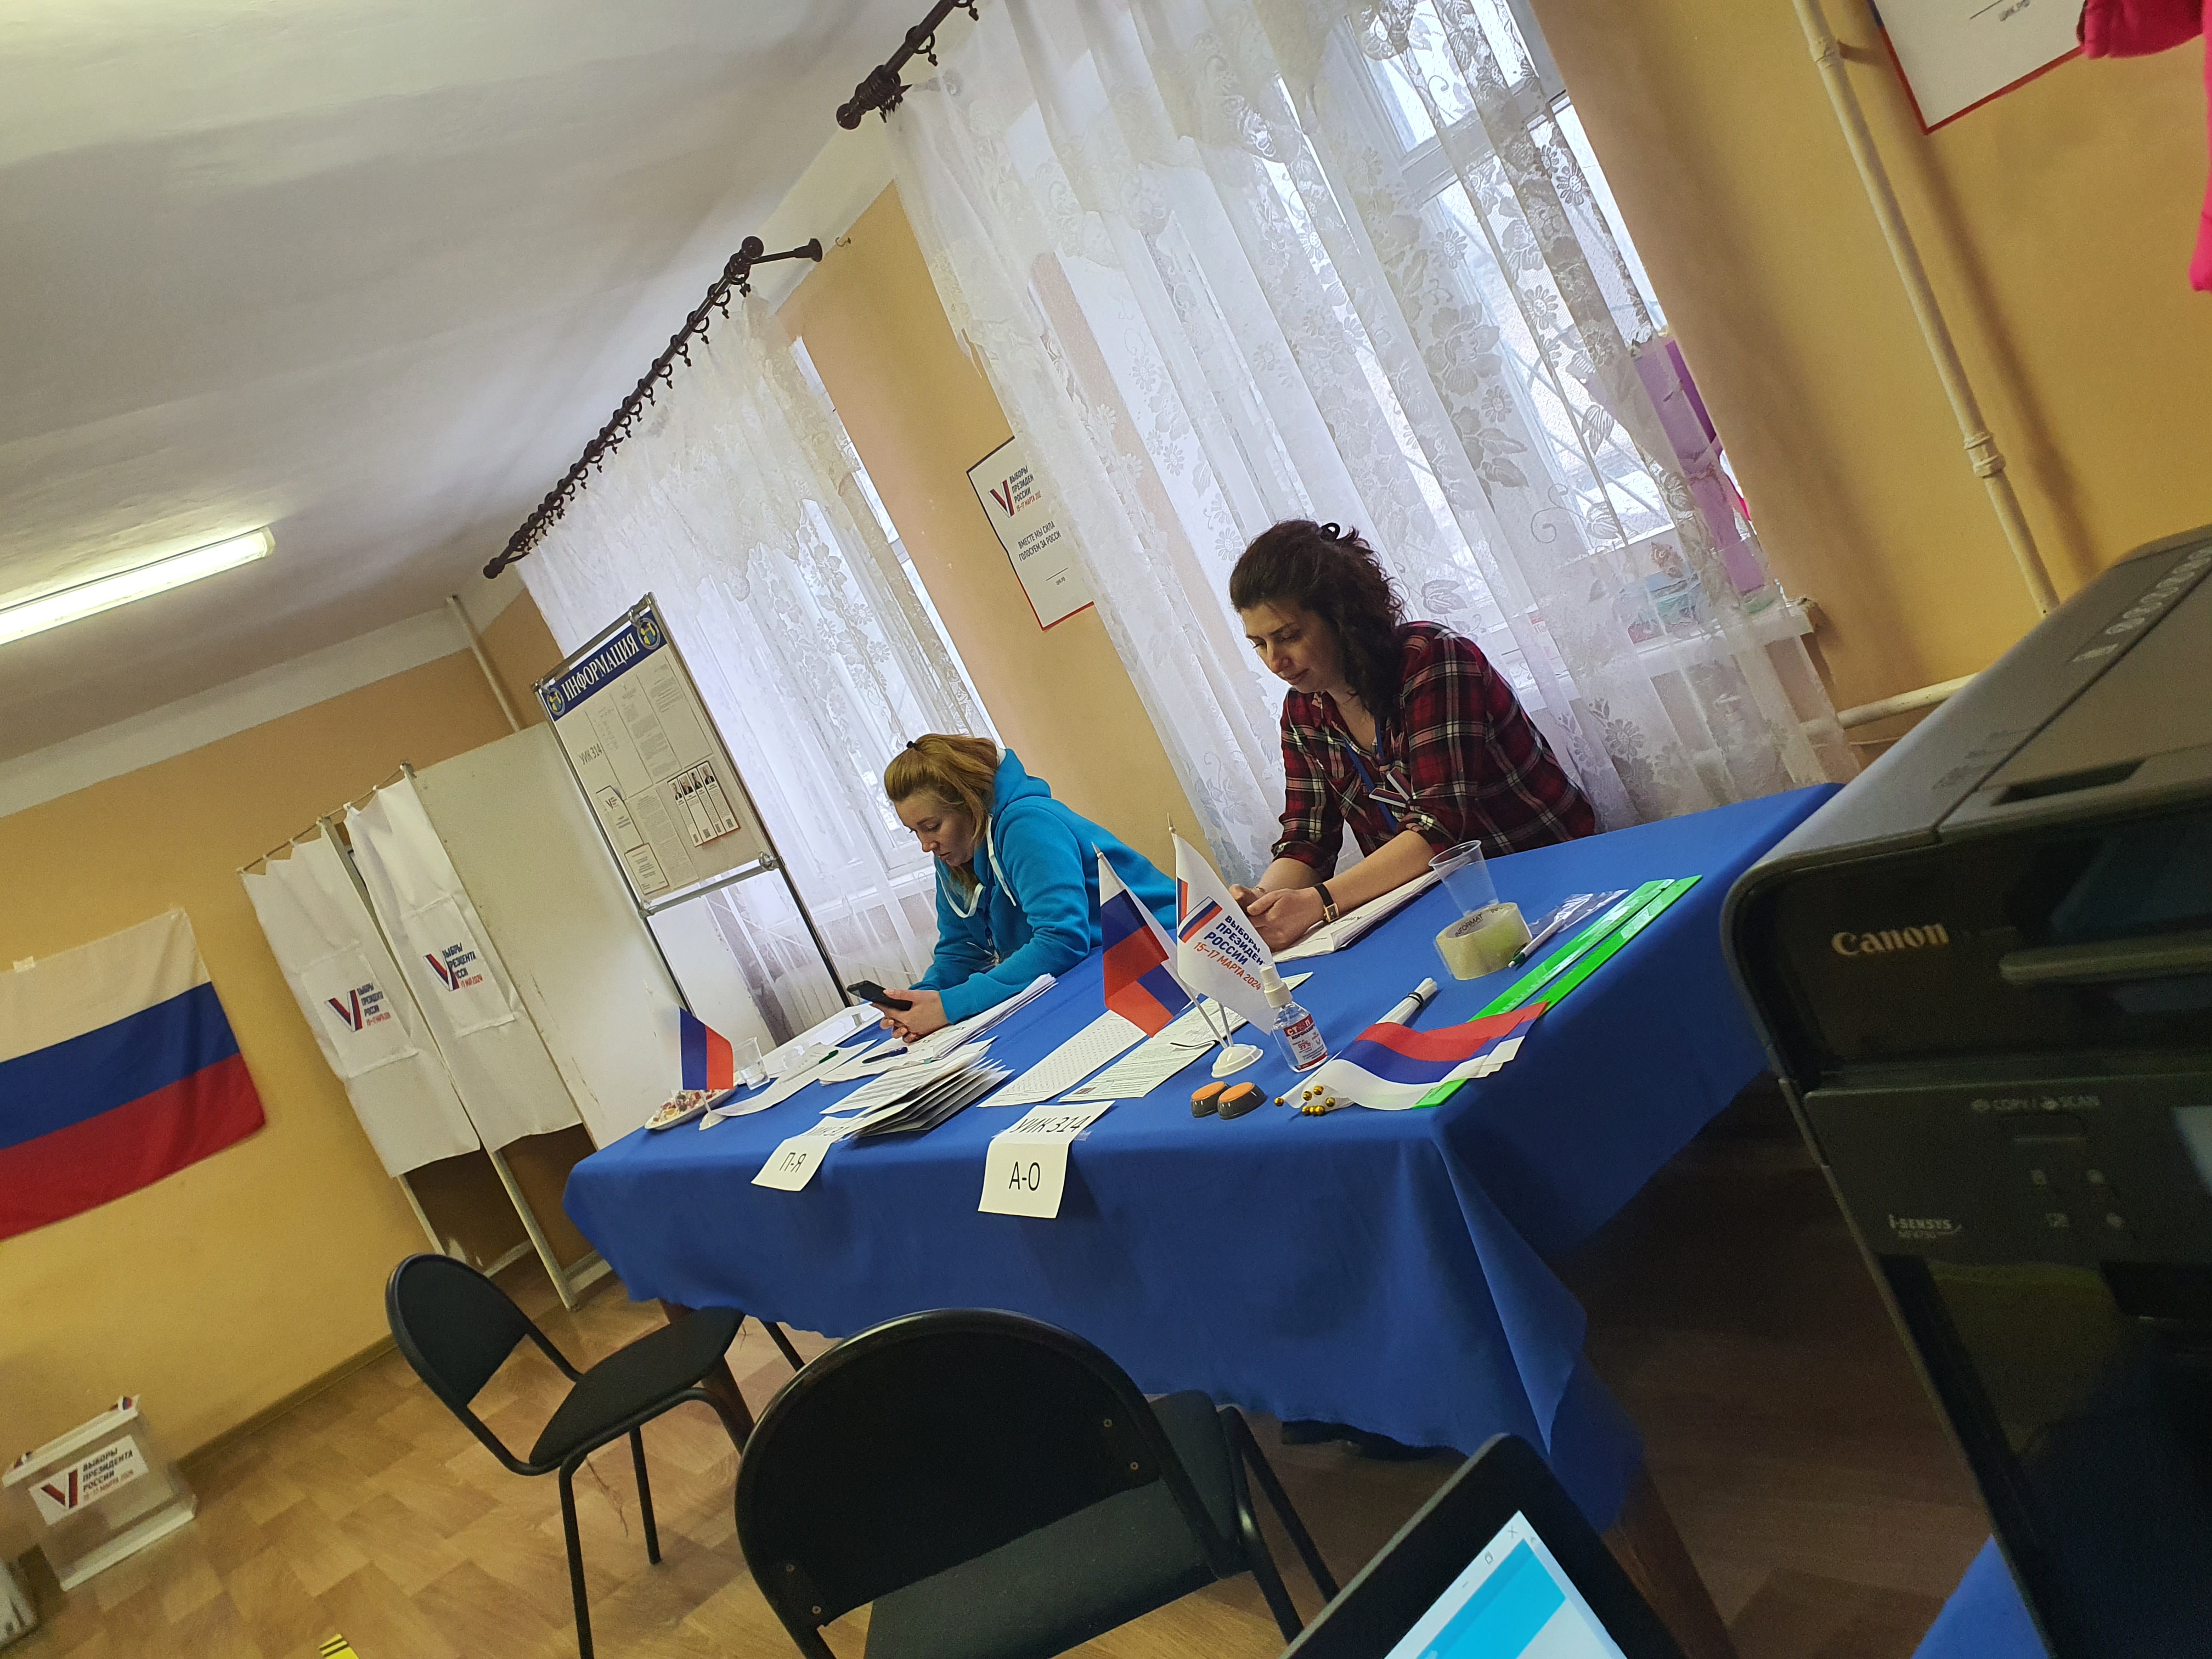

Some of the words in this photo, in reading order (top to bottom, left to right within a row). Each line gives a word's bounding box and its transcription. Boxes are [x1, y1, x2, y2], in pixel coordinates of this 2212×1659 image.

[1009, 465, 1029, 484] ВЫБОРЫ
[1011, 473, 1034, 494] ПРЕЗИДЕН
[1014, 486, 1031, 504] РОССИИ
[1018, 533, 1035, 549] ВМЕСТЕ
[1034, 527, 1043, 539] МЫ
[1042, 521, 1056, 534] СИЛА
[1018, 543, 1042, 562] ГОЛОСУЕМ
[1040, 539, 1047, 549] ЗА
[1045, 529, 1062, 545] РОССИ
[561, 633, 640, 702] ИНФОРМАЦИЯ
[578, 746, 591, 765] УИК
[590, 743, 602, 759] 314
[1224, 915, 1261, 953] ВЫБОРЫ
[1454, 911, 1483, 937] INFORMAT
[1203, 931, 1249, 965] РОССИИ
[1215, 922, 1265, 966] ПРЕЗИДЕН
[1831, 923, 1949, 956] Canon
[1193, 941, 1220, 959] 15–17
[1216, 955, 1245, 978] МАРТА
[1243, 974, 1261, 990] 2024
[1297, 1040, 1311, 1051] 99%
[1009, 1117, 1058, 1133] УИК
[1046, 1115, 1092, 1133] 314
[778, 1152, 807, 1173] П-Я
[1008, 1160, 1041, 1192] А-О
[82, 1447, 117, 1472] ВЫБОРЫ
[82, 1449, 133, 1482] ПРЕЗИДЕНТА
